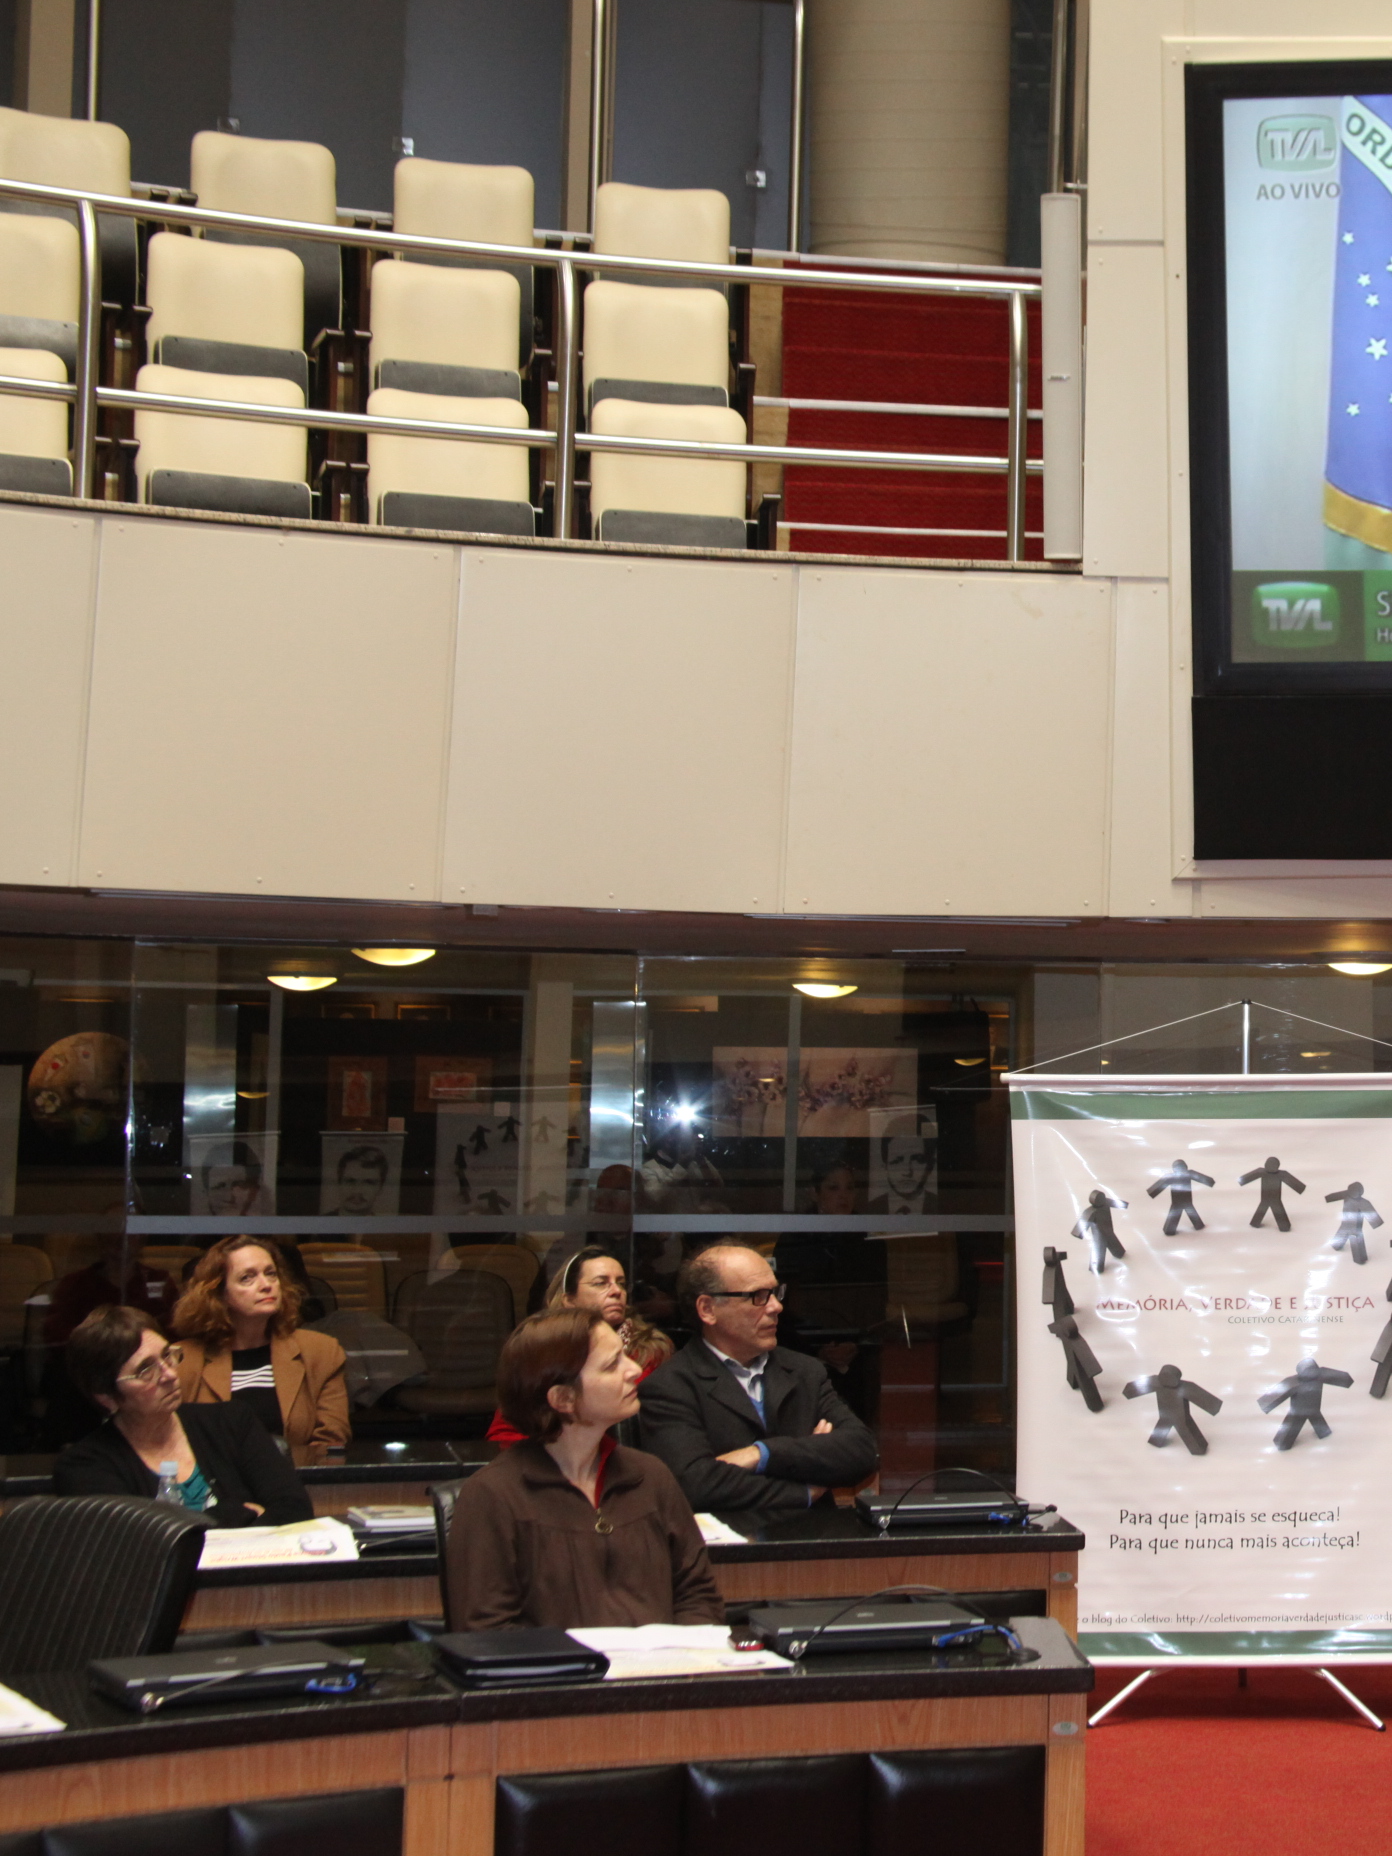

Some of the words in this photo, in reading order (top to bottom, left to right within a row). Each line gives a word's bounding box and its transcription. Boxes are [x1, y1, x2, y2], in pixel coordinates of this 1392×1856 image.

[1256, 183, 1286, 201] AO
[1290, 182, 1342, 200] VIVO
[1290, 1296, 1297, 1310] E
[1304, 1296, 1375, 1313] STIÇA
[1227, 1315, 1275, 1325] COLETIVO
[1119, 1509, 1152, 1525] Para
[1158, 1511, 1189, 1529] que
[1194, 1509, 1245, 1528] jamais
[1250, 1511, 1267, 1523] se
[1109, 1534, 1142, 1550] Para
[1148, 1536, 1179, 1555] que
[1184, 1537, 1234, 1550] nunca
[1240, 1534, 1277, 1549] mais
[1281, 1531, 1361, 1550] aconteça!
[1081, 1616, 1089, 1624] o
[1091, 1613, 1113, 1626] blog
[1115, 1613, 1128, 1624] do
[1130, 1613, 1173, 1624] Coletivo:
